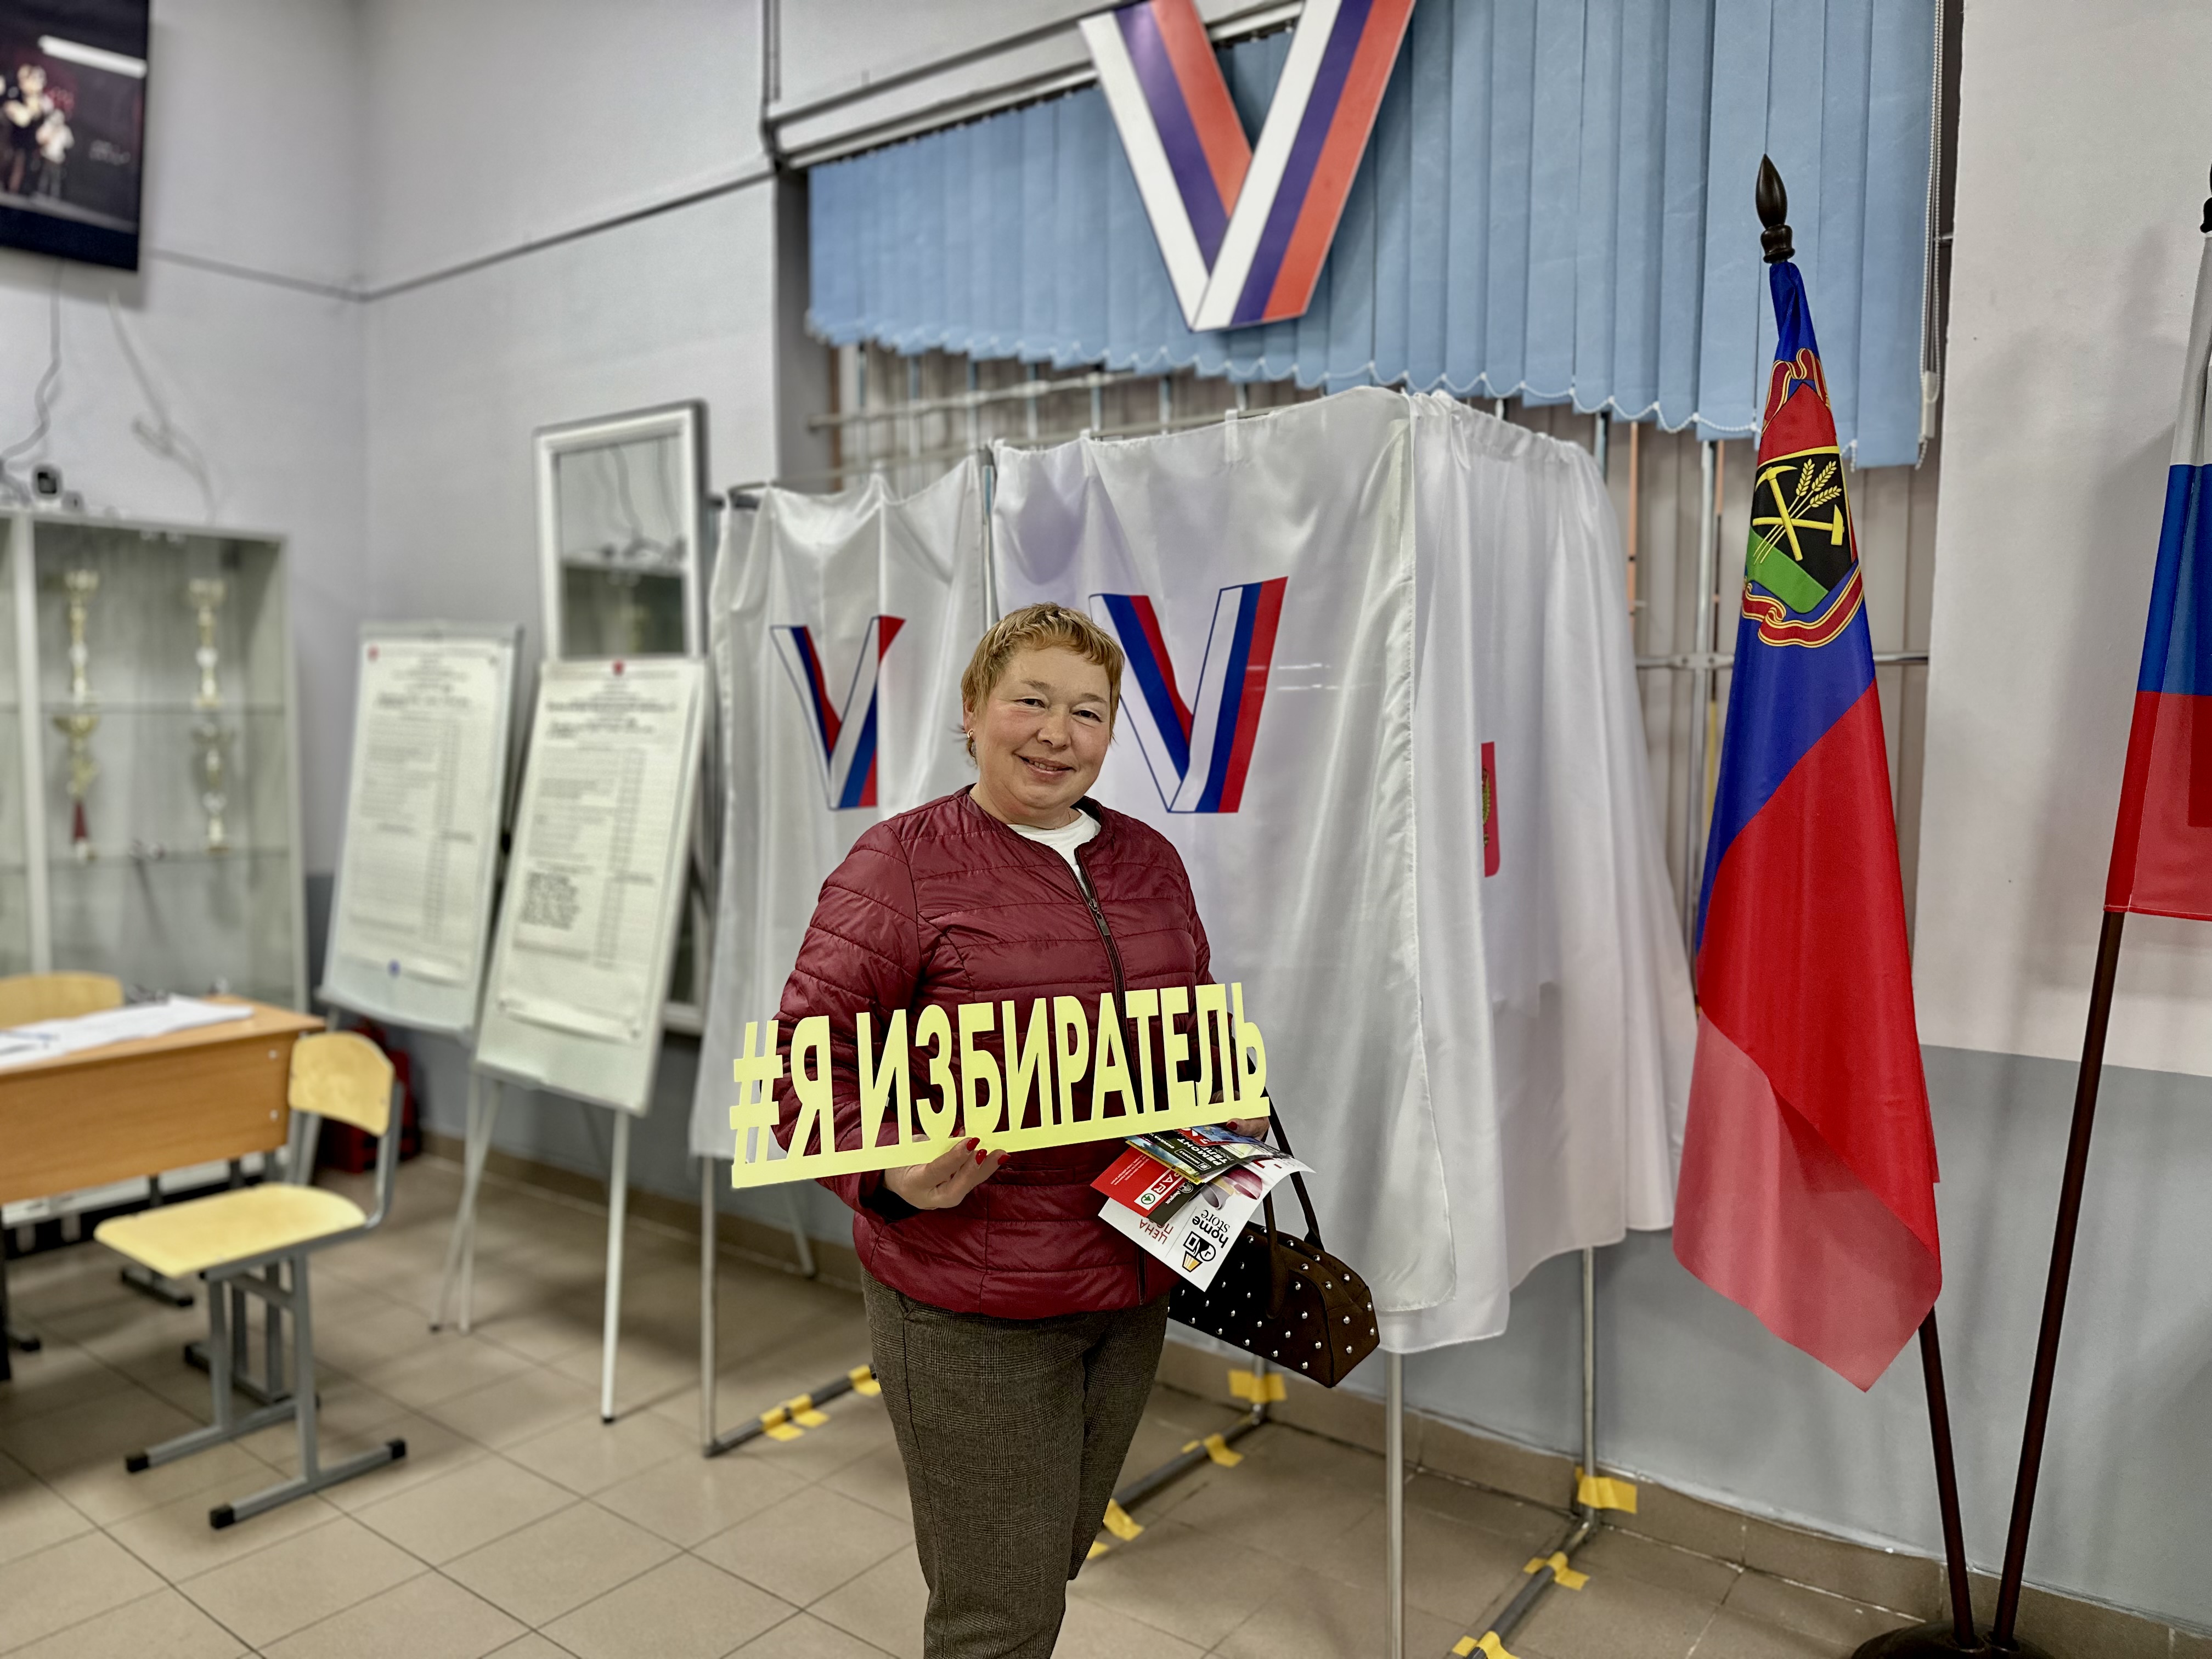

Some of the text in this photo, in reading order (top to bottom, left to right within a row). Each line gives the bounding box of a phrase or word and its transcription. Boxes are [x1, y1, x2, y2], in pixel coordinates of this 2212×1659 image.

[730, 982, 1268, 1166] #Я ИЗБИРАТЕЛЬ
[1177, 1138, 1222, 1166] РЕМОНТ
[1153, 1172, 1180, 1194] PAR
[1139, 1218, 1168, 1245] ЦЕНА
[1192, 1215, 1229, 1249] home
[1201, 1209, 1231, 1233] store
